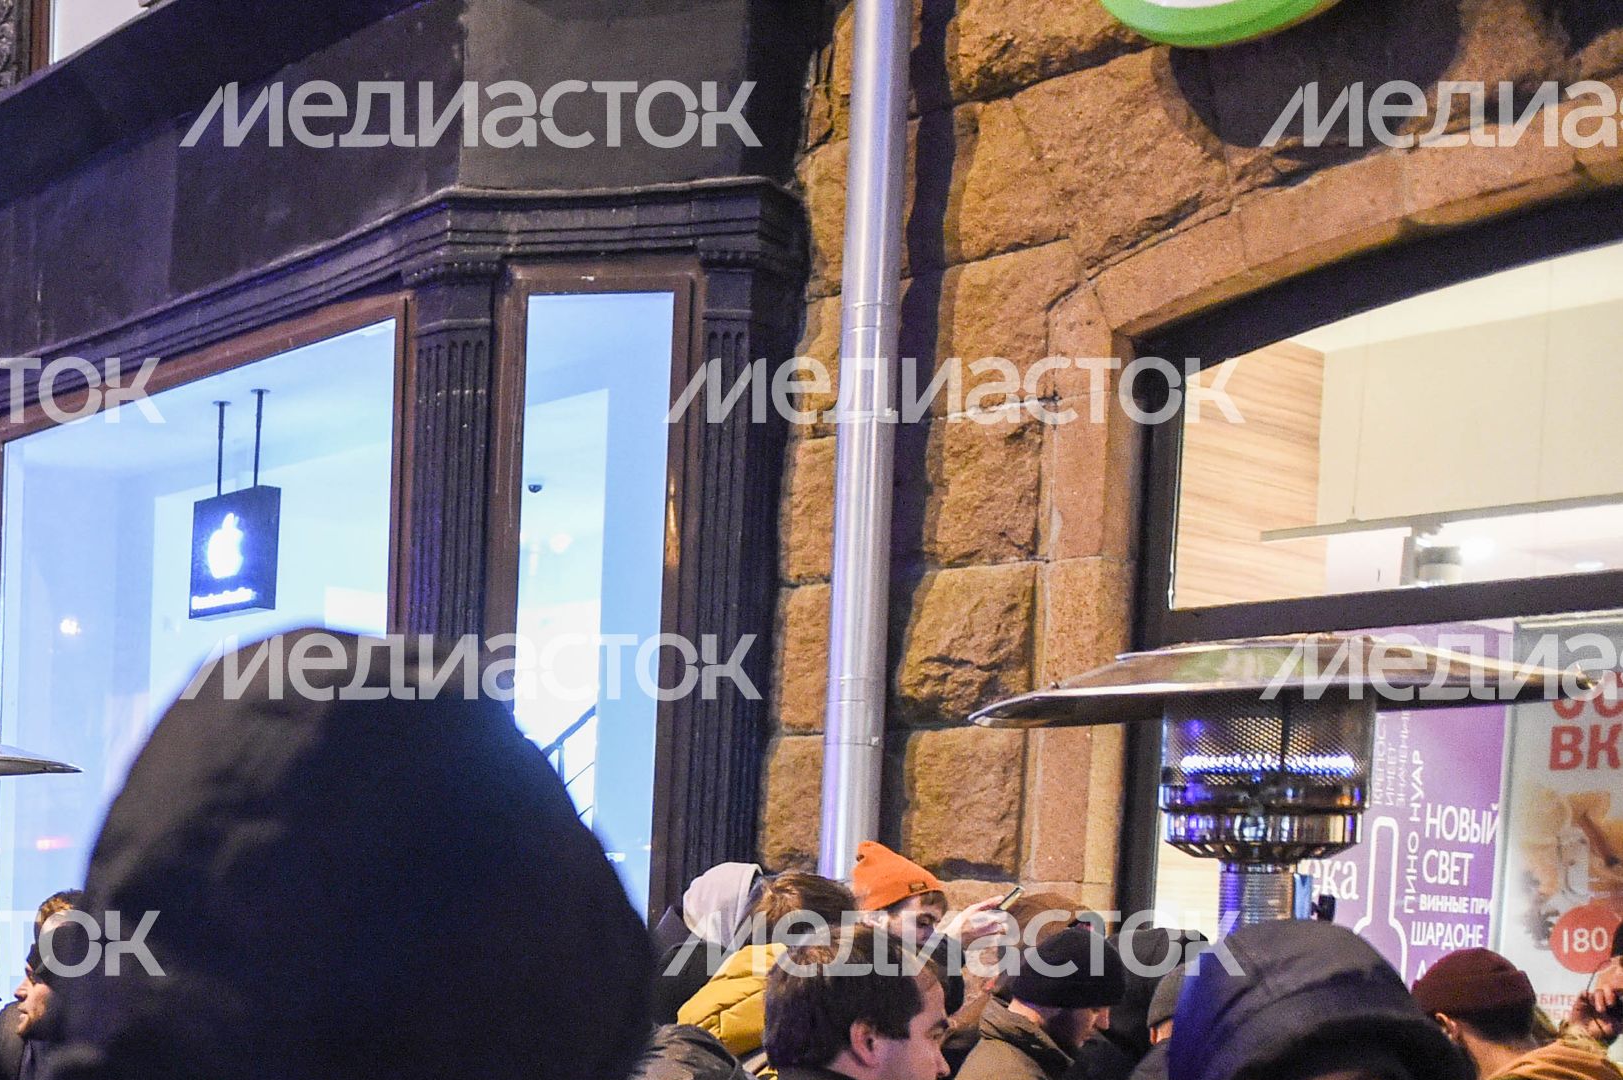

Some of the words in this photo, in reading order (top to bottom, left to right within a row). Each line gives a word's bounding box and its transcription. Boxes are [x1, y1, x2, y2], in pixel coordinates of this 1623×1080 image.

[1409, 749, 1425, 822] НУАР
[1425, 801, 1499, 846] НОВЫЙ
[1403, 831, 1420, 914] ПИНО
[1422, 848, 1474, 887] СВЕТ
[1419, 893, 1469, 915] ВИННЫЕ
[1411, 921, 1484, 951] ШАРДОНЕ
[1561, 927, 1608, 954] 180
